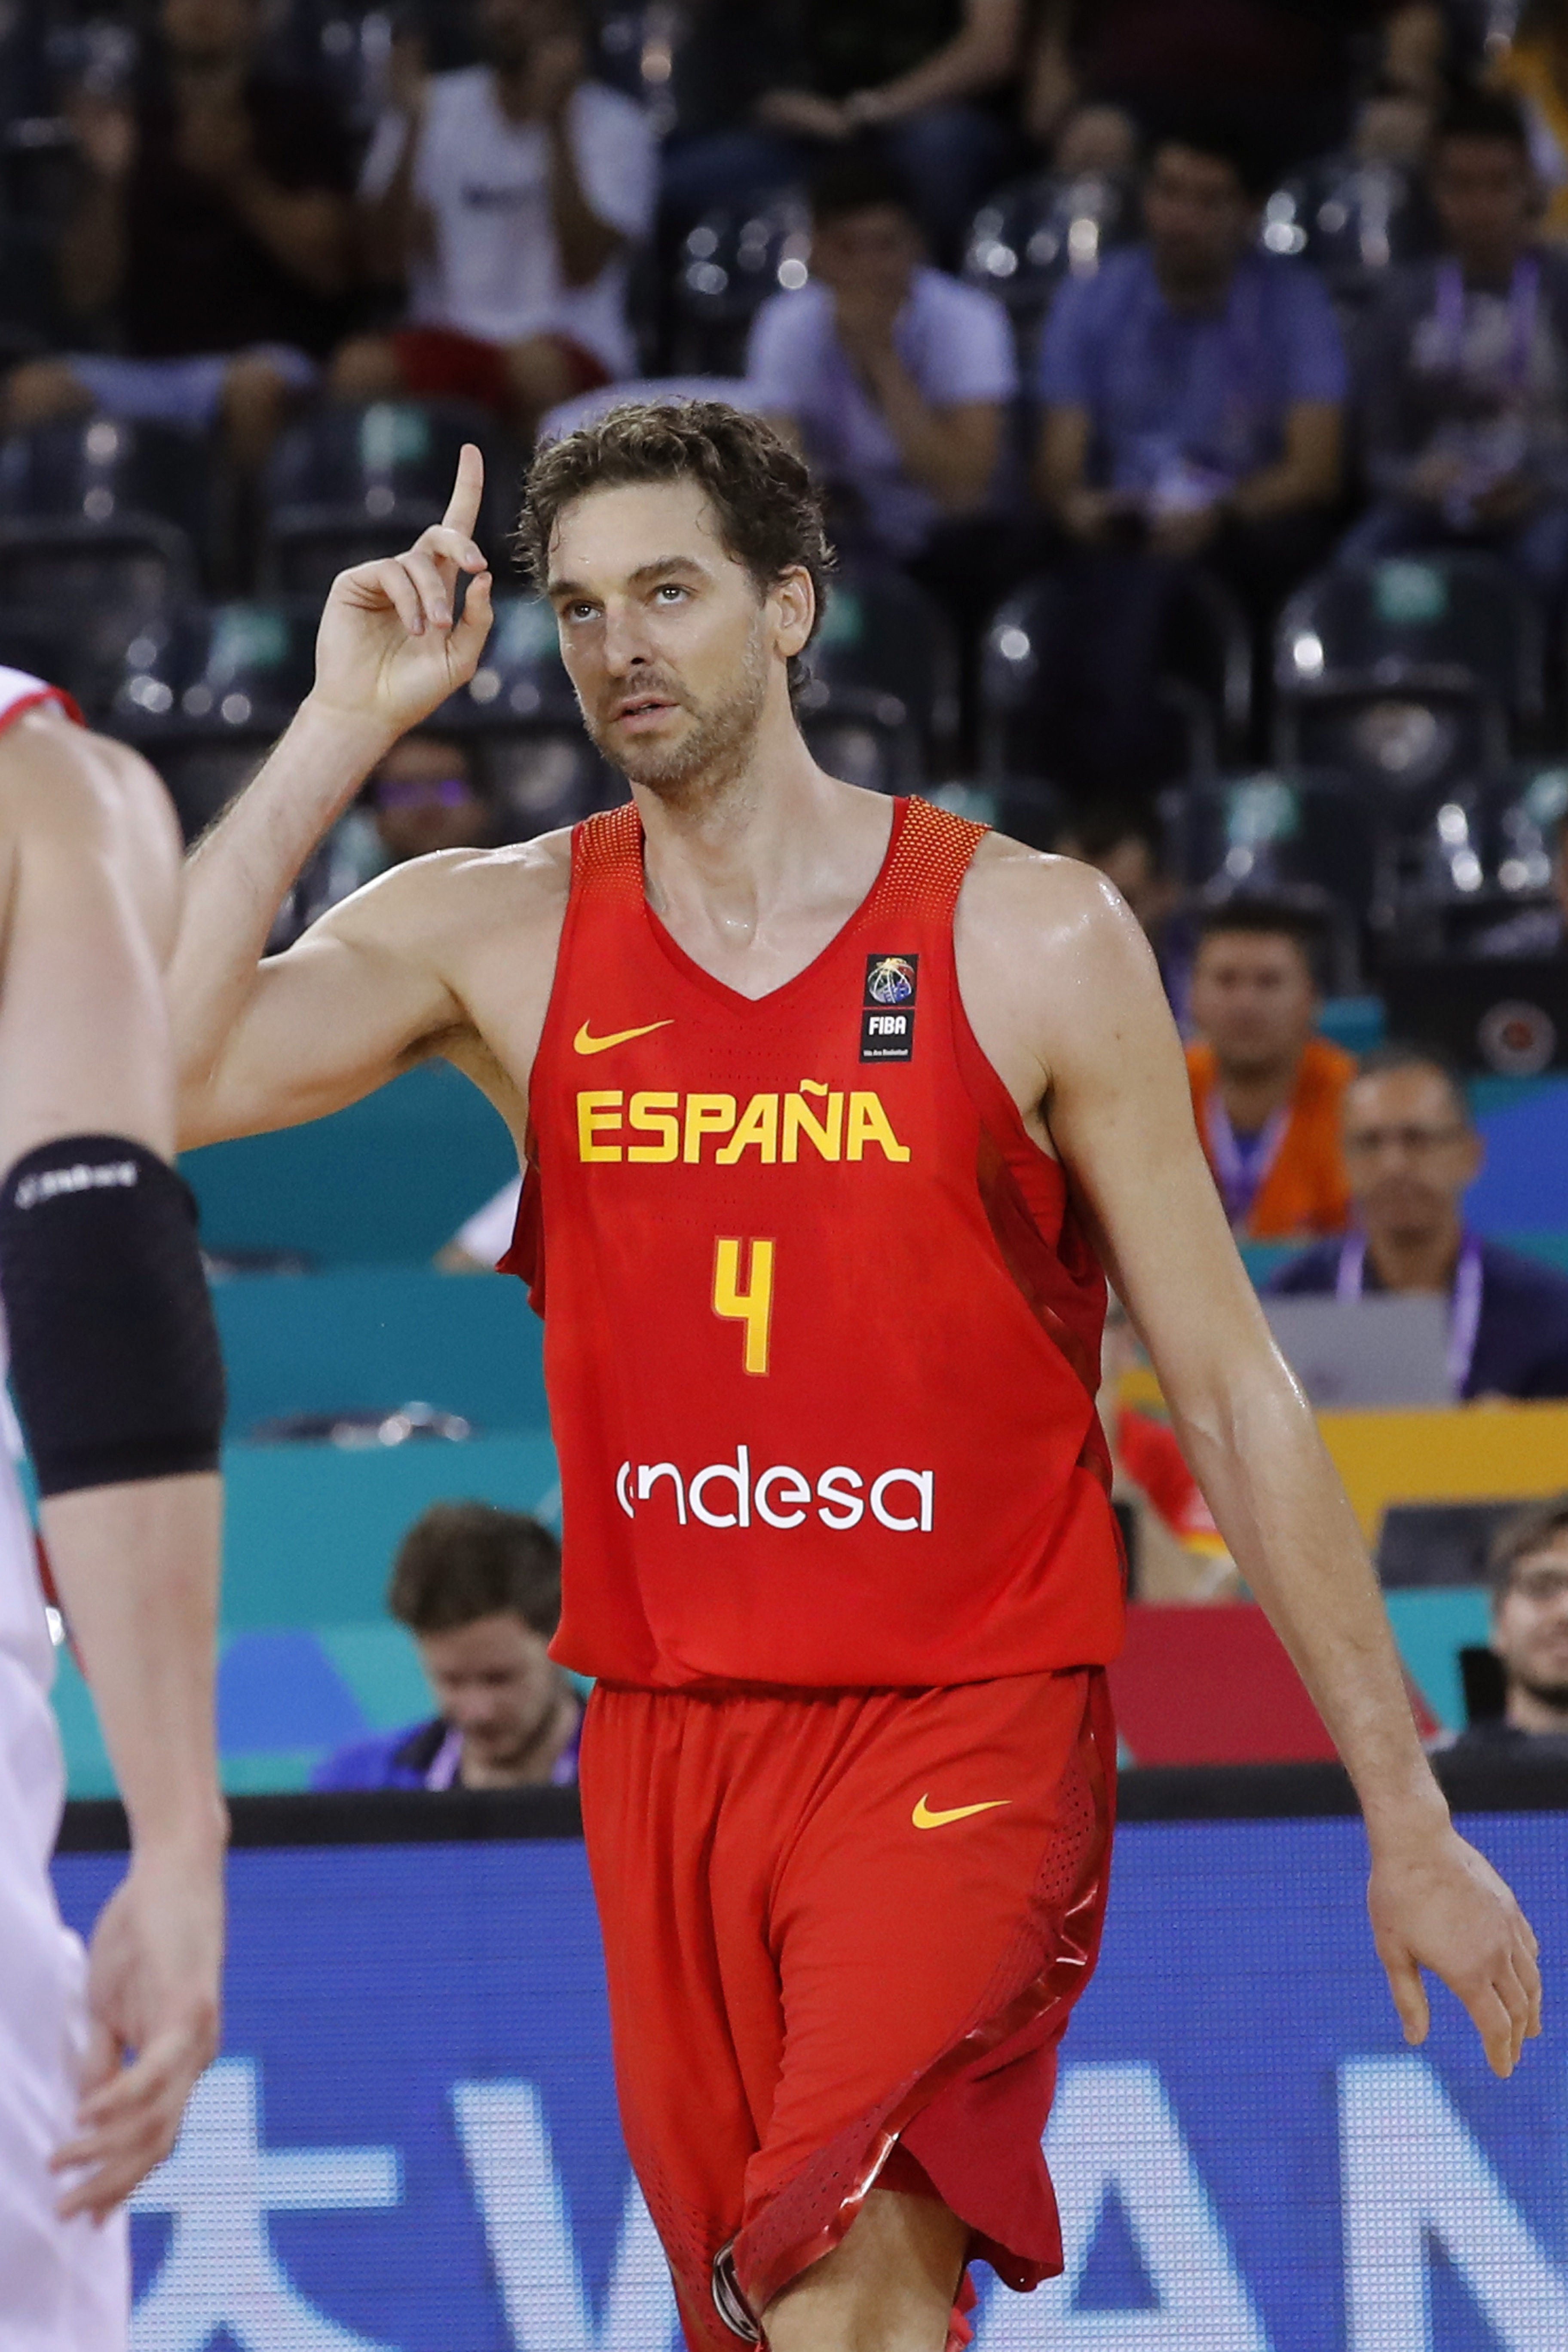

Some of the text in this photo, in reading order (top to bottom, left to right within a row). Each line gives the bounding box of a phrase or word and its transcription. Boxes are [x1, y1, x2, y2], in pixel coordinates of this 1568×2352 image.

[869, 1016, 906, 1035] FIBA
[576, 1079, 911, 1164] ESPAÑA
[713, 1238, 774, 1375] 4
